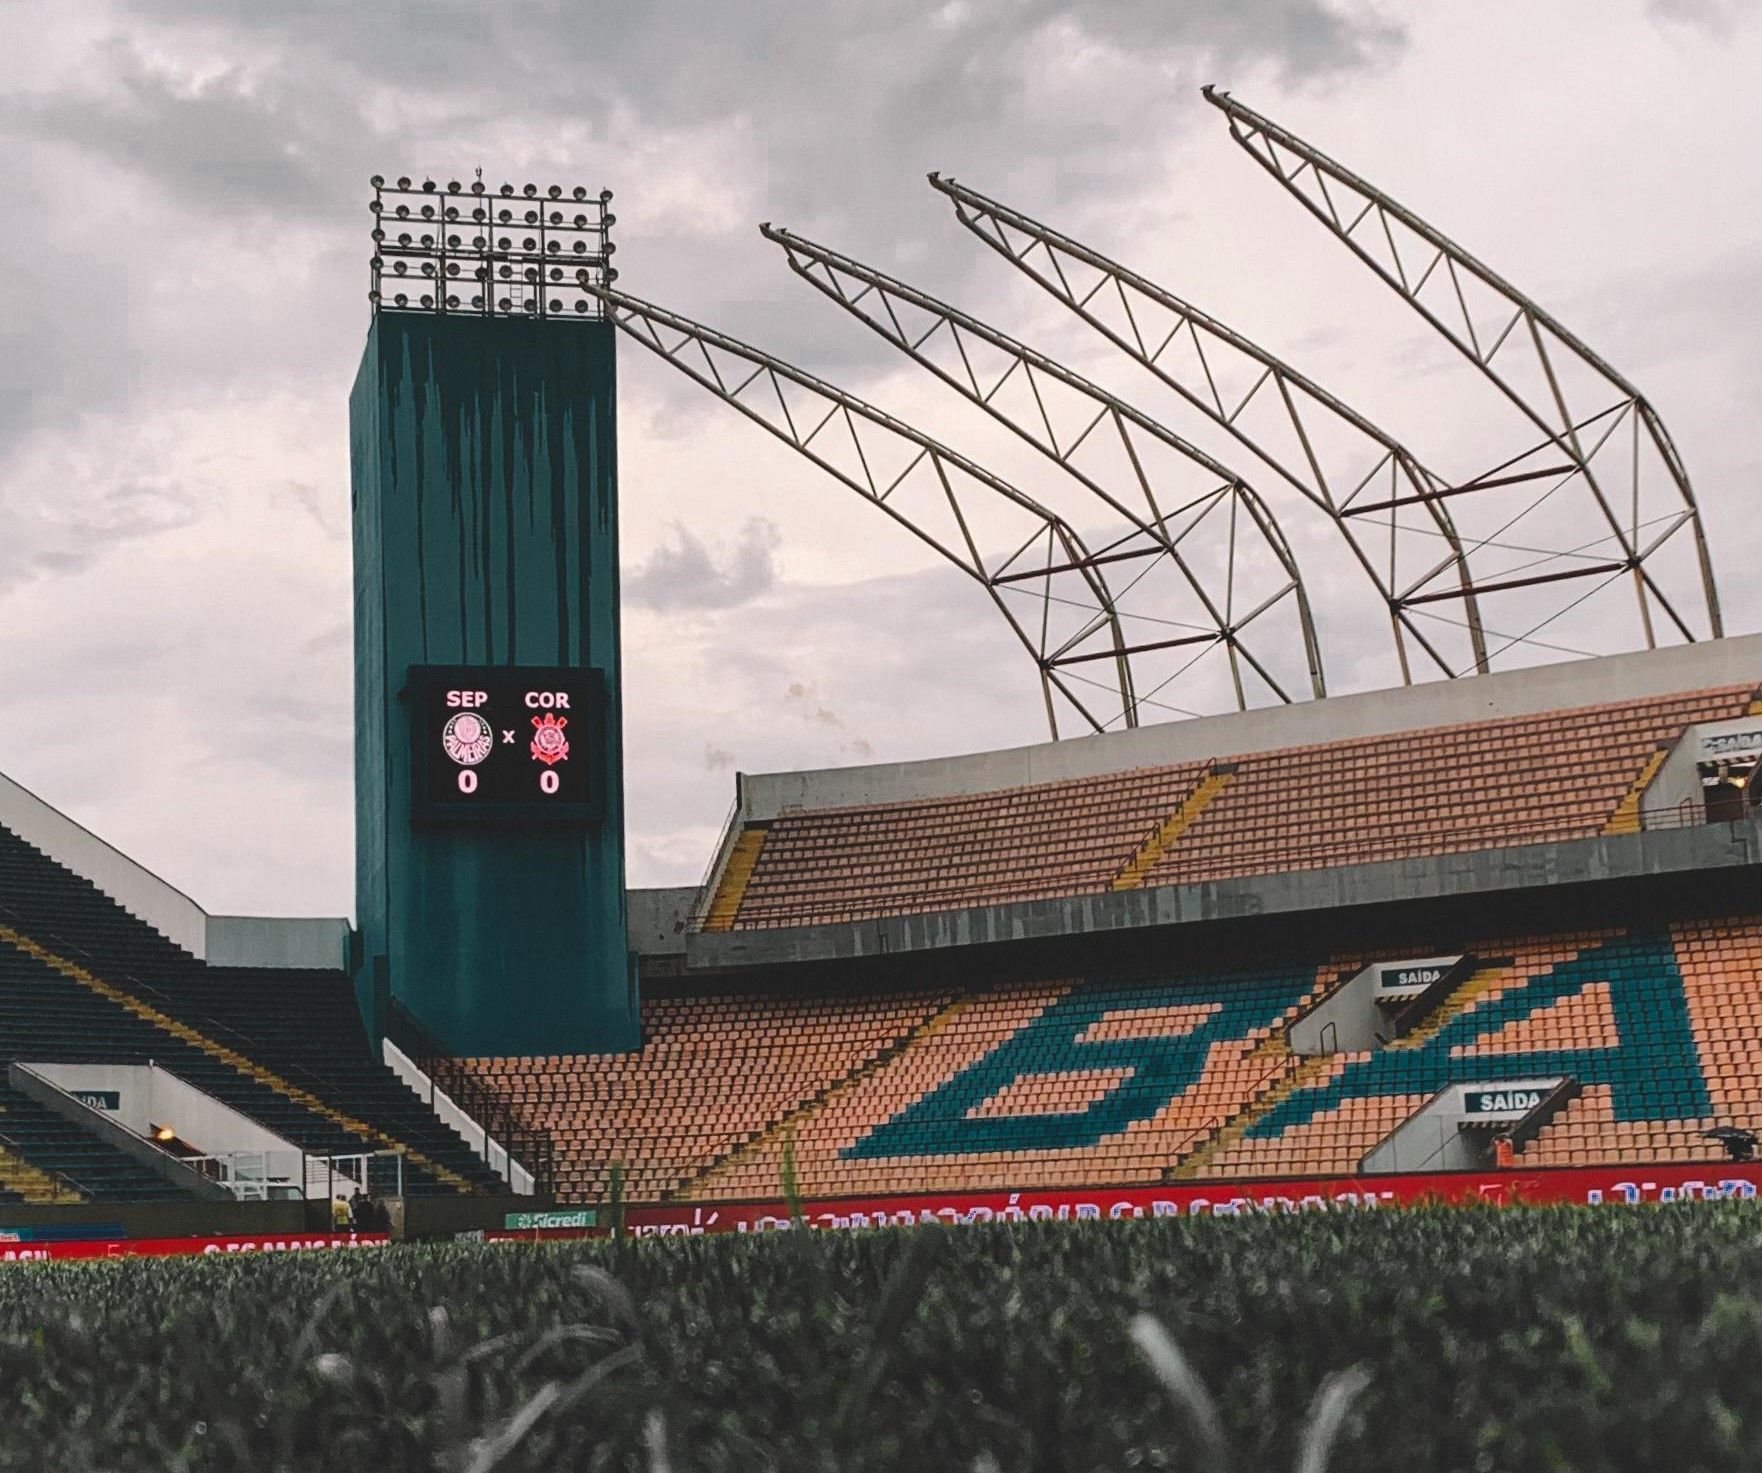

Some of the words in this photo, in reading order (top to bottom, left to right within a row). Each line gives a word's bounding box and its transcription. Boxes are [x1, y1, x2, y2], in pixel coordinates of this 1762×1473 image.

[446, 691, 488, 707] SEP
[525, 692, 570, 708] COR
[458, 770, 477, 793] 0
[540, 770, 559, 793] 0
[532, 1213, 587, 1228] Sicredi
